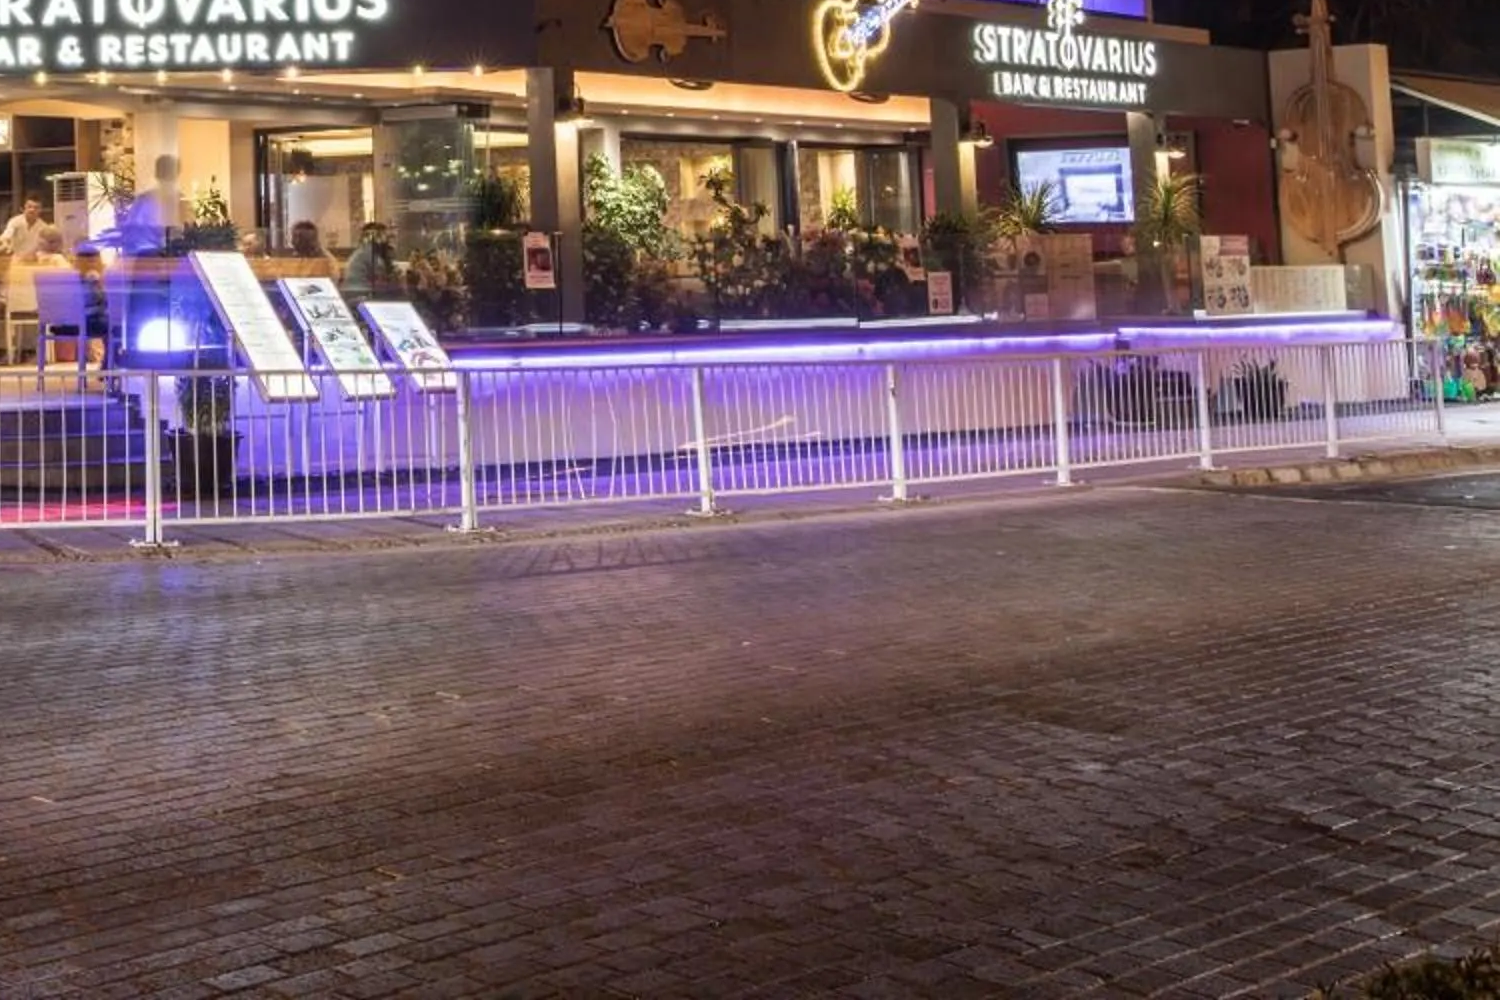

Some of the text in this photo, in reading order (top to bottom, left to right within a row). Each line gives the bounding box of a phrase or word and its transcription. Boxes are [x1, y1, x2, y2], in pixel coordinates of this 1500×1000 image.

[57, 34, 85, 66] &
[99, 31, 355, 65] RESTAURANT
[974, 23, 1159, 76] STRATOVARIUS
[993, 70, 1037, 98] BAR
[1053, 76, 1148, 105] RESTAURANT
